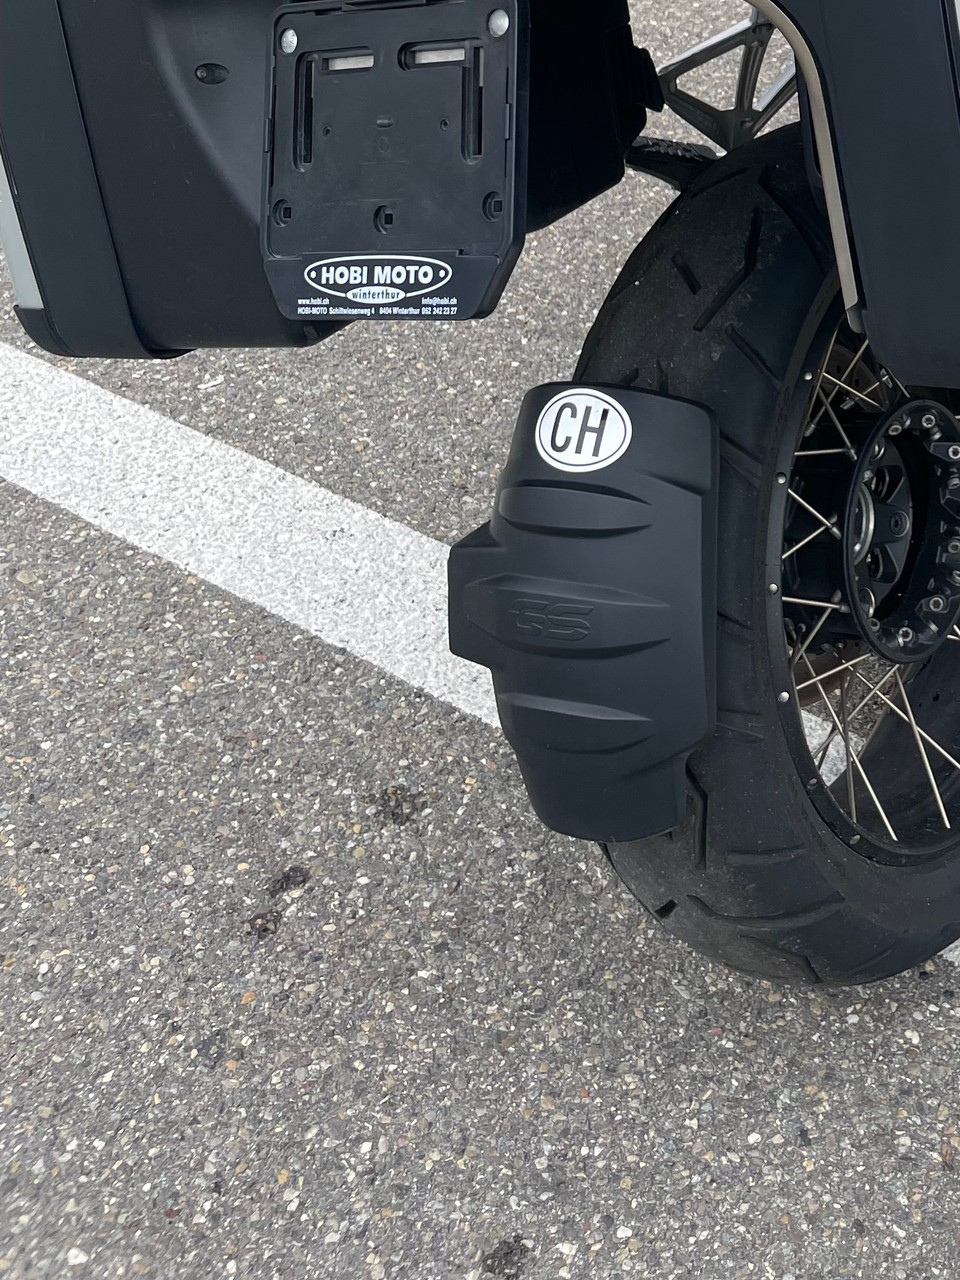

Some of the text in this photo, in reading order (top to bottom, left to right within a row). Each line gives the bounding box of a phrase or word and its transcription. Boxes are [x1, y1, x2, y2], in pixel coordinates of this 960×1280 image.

[321, 265, 434, 285] HOBI MOTO
[351, 288, 401, 300] winterthur
[297, 297, 330, 305] www.hobi.ch
[297, 306, 328, 315] HOBI-MOTO
[392, 306, 420, 315] Winterthur
[421, 306, 432, 315] 052
[432, 306, 443, 315] 242
[450, 306, 458, 315] 27
[549, 401, 610, 458] CH
